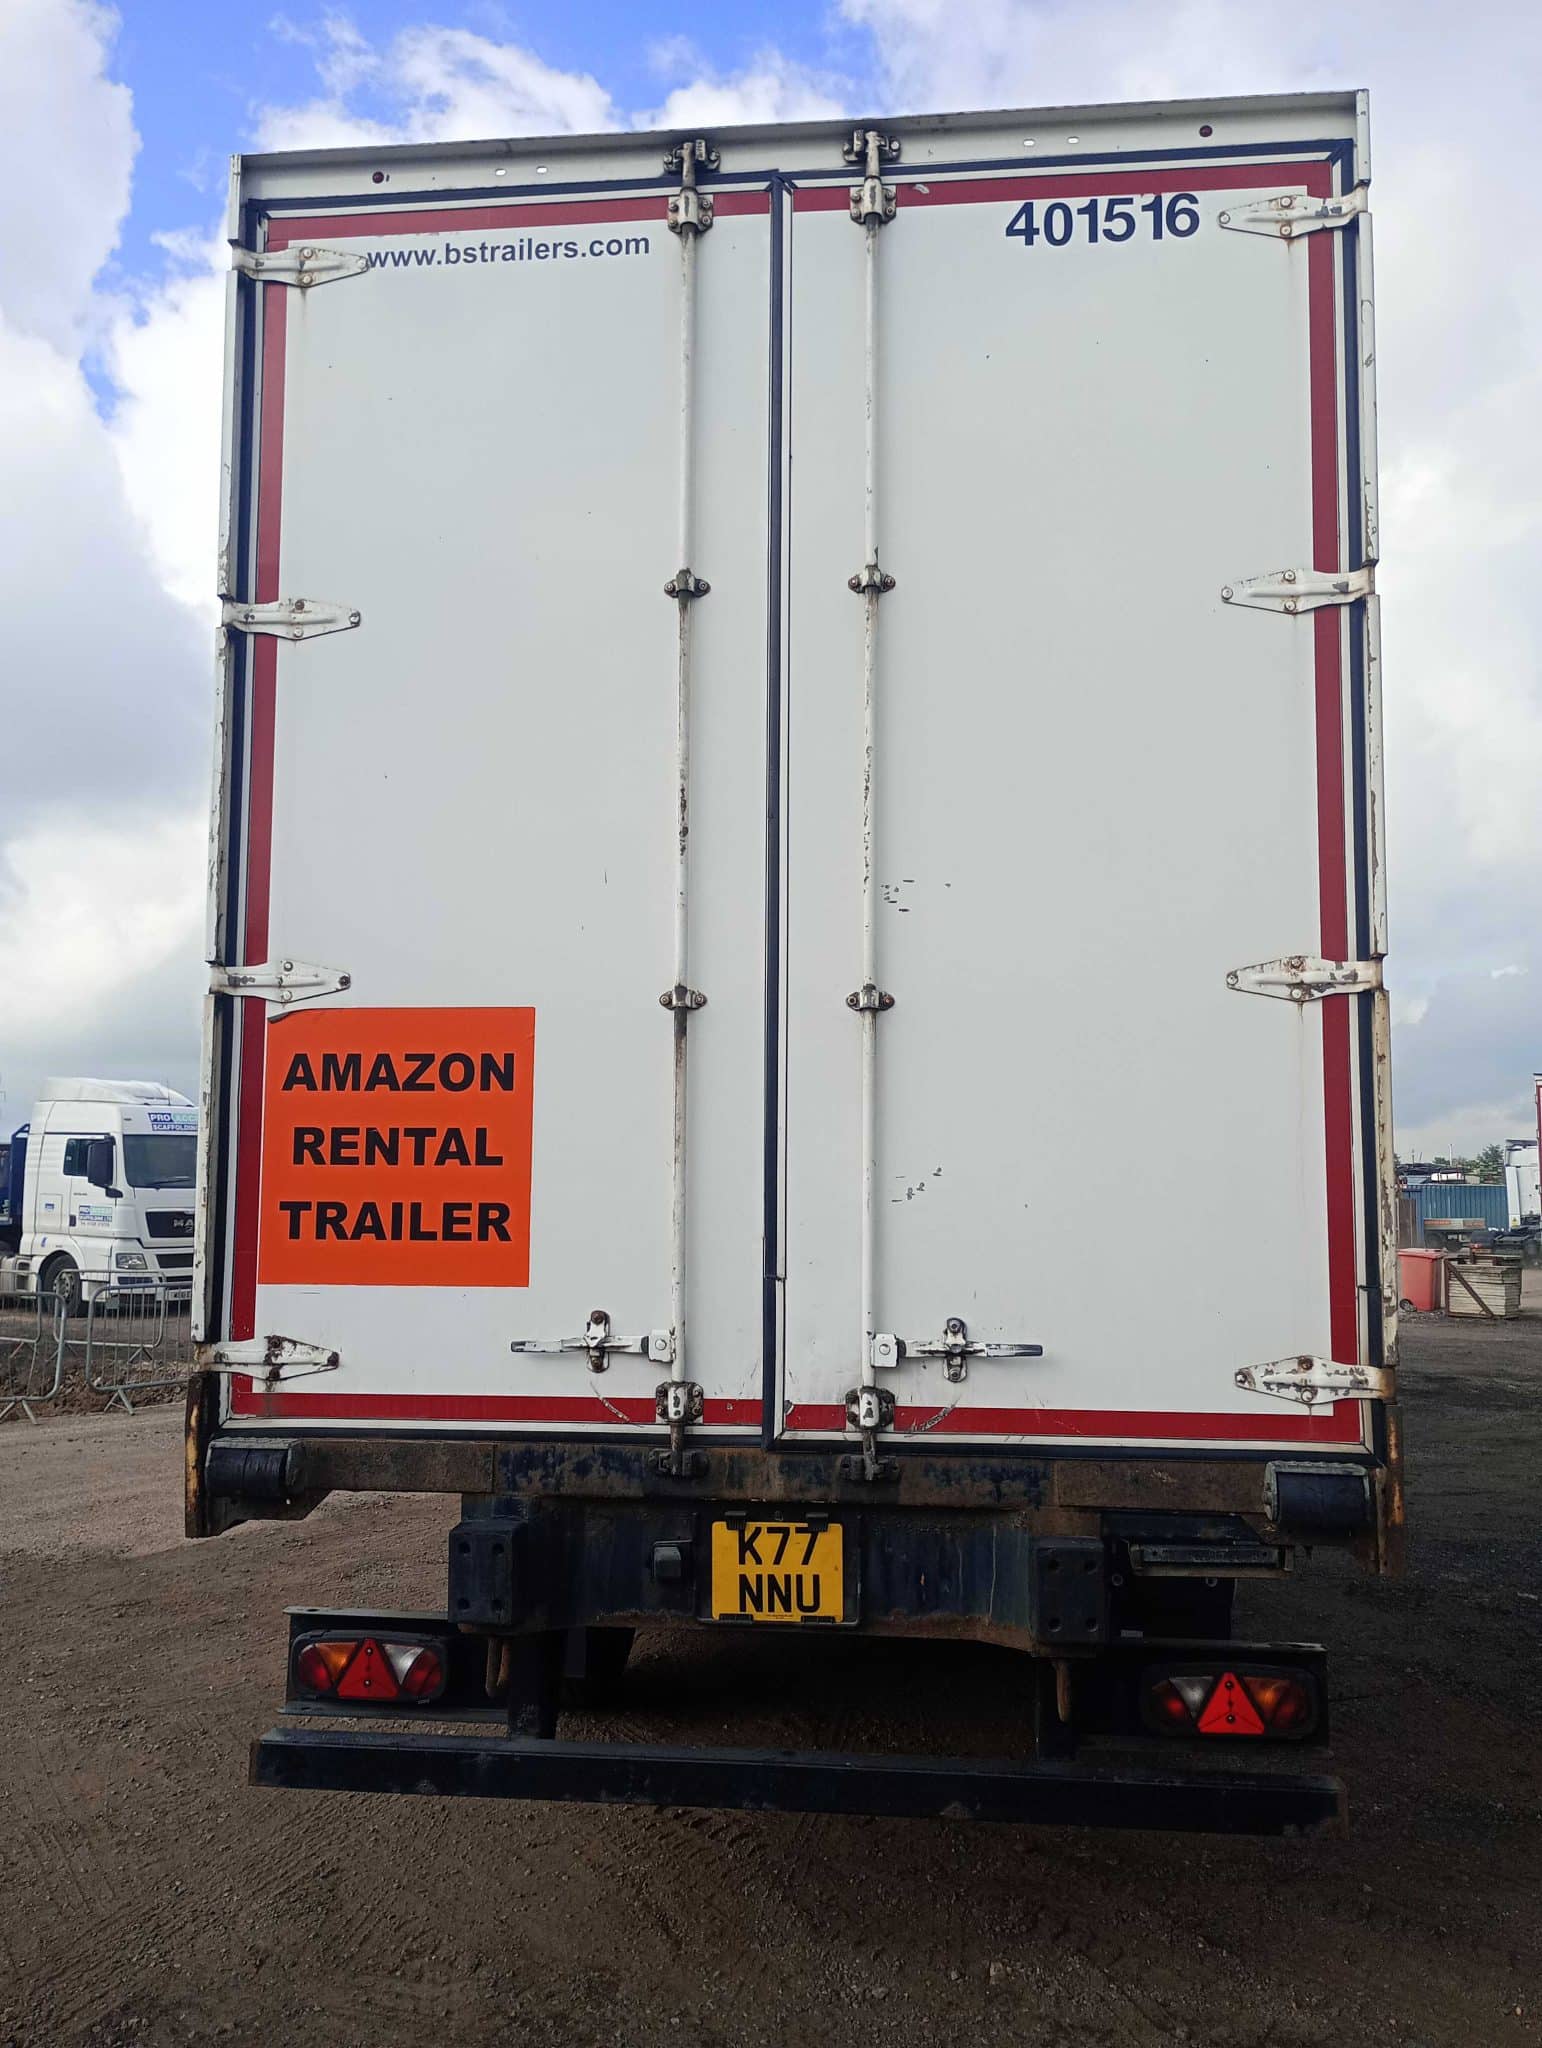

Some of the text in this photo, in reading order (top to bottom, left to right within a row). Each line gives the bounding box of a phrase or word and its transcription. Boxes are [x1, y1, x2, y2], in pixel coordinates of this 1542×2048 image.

[1005, 193, 1200, 246] 401516
[367, 236, 650, 268] www.bstrailers.com
[281, 1052, 515, 1092] AMAZON
[292, 1126, 504, 1166] RENTAL
[279, 1201, 512, 1241] TRAILER
[737, 1526, 820, 1566] K77
[738, 1573, 820, 1613] NNU
